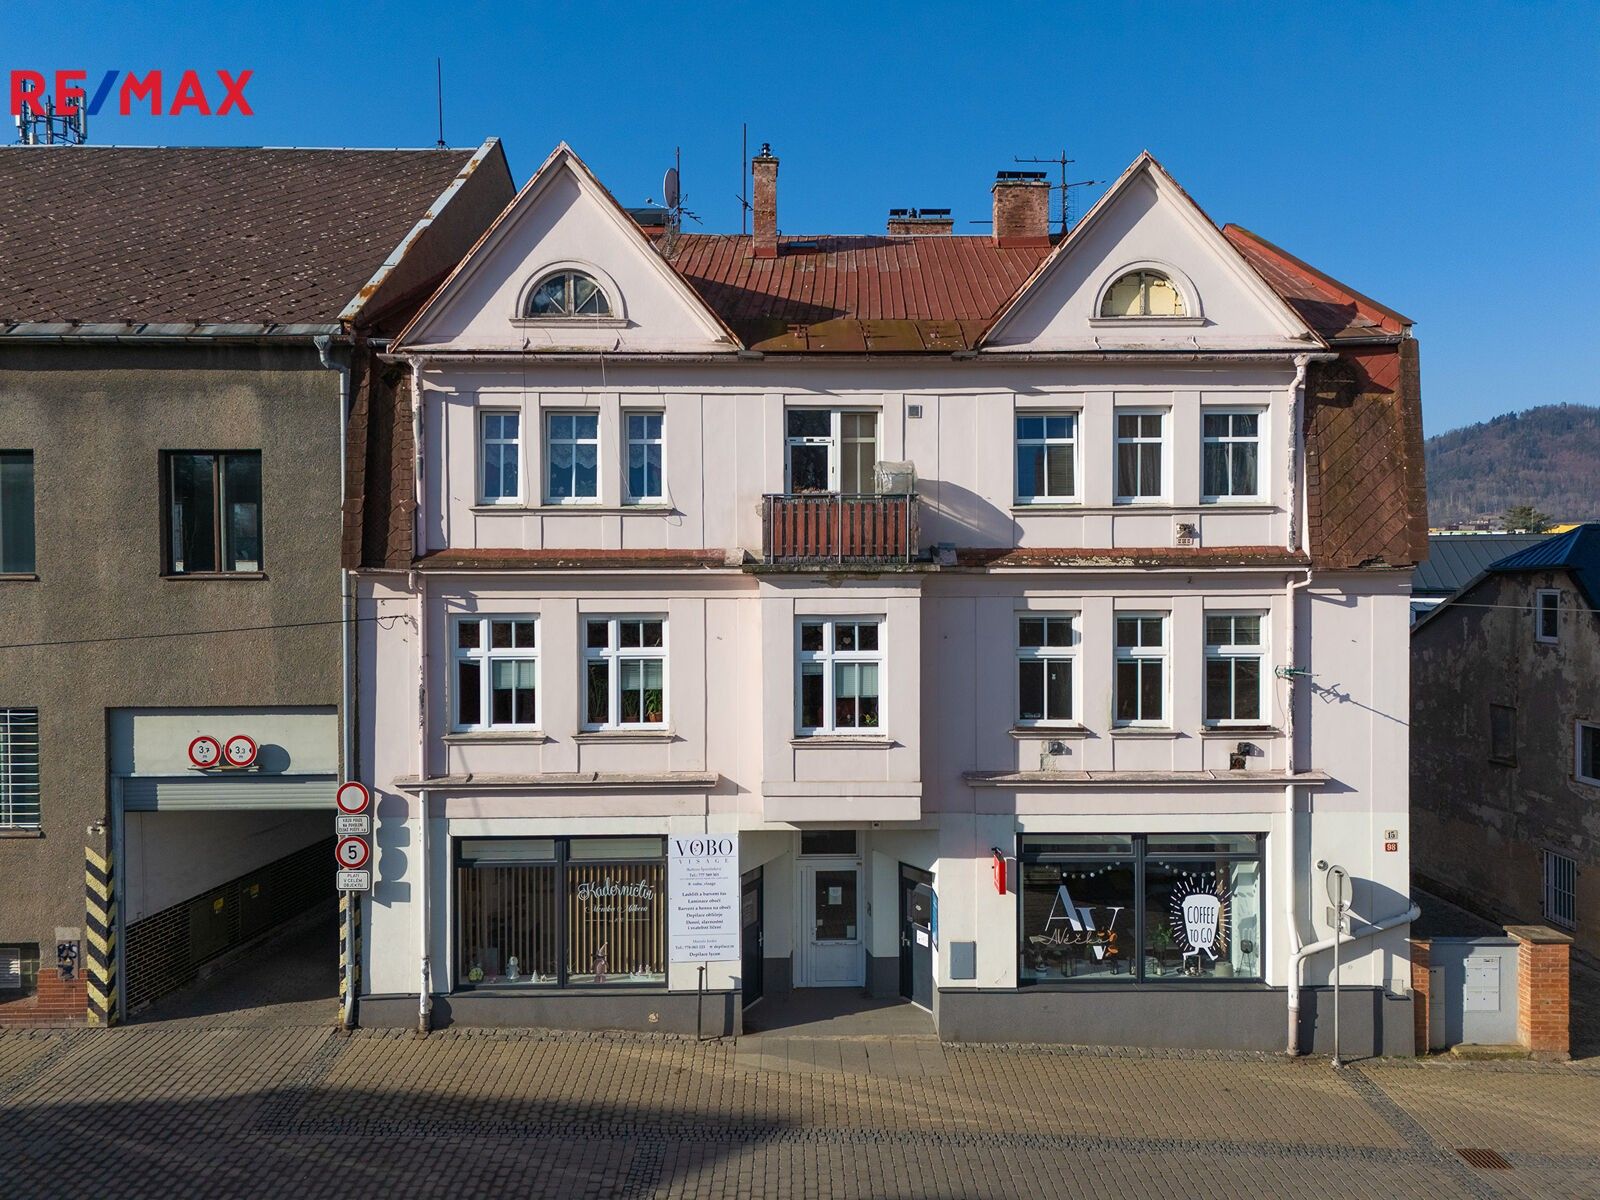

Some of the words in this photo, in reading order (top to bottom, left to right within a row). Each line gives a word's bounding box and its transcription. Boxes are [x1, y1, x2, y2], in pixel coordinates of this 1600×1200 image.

[348, 845, 357, 860] 5
[676, 839, 733, 857] VOBO
[1386, 843, 1397, 851] 98
[578, 876, 655, 900] Kadeřnictví
[1188, 906, 1214, 924] COFFEE
[1190, 929, 1199, 943] TO
[1201, 928, 1212, 943] GO
